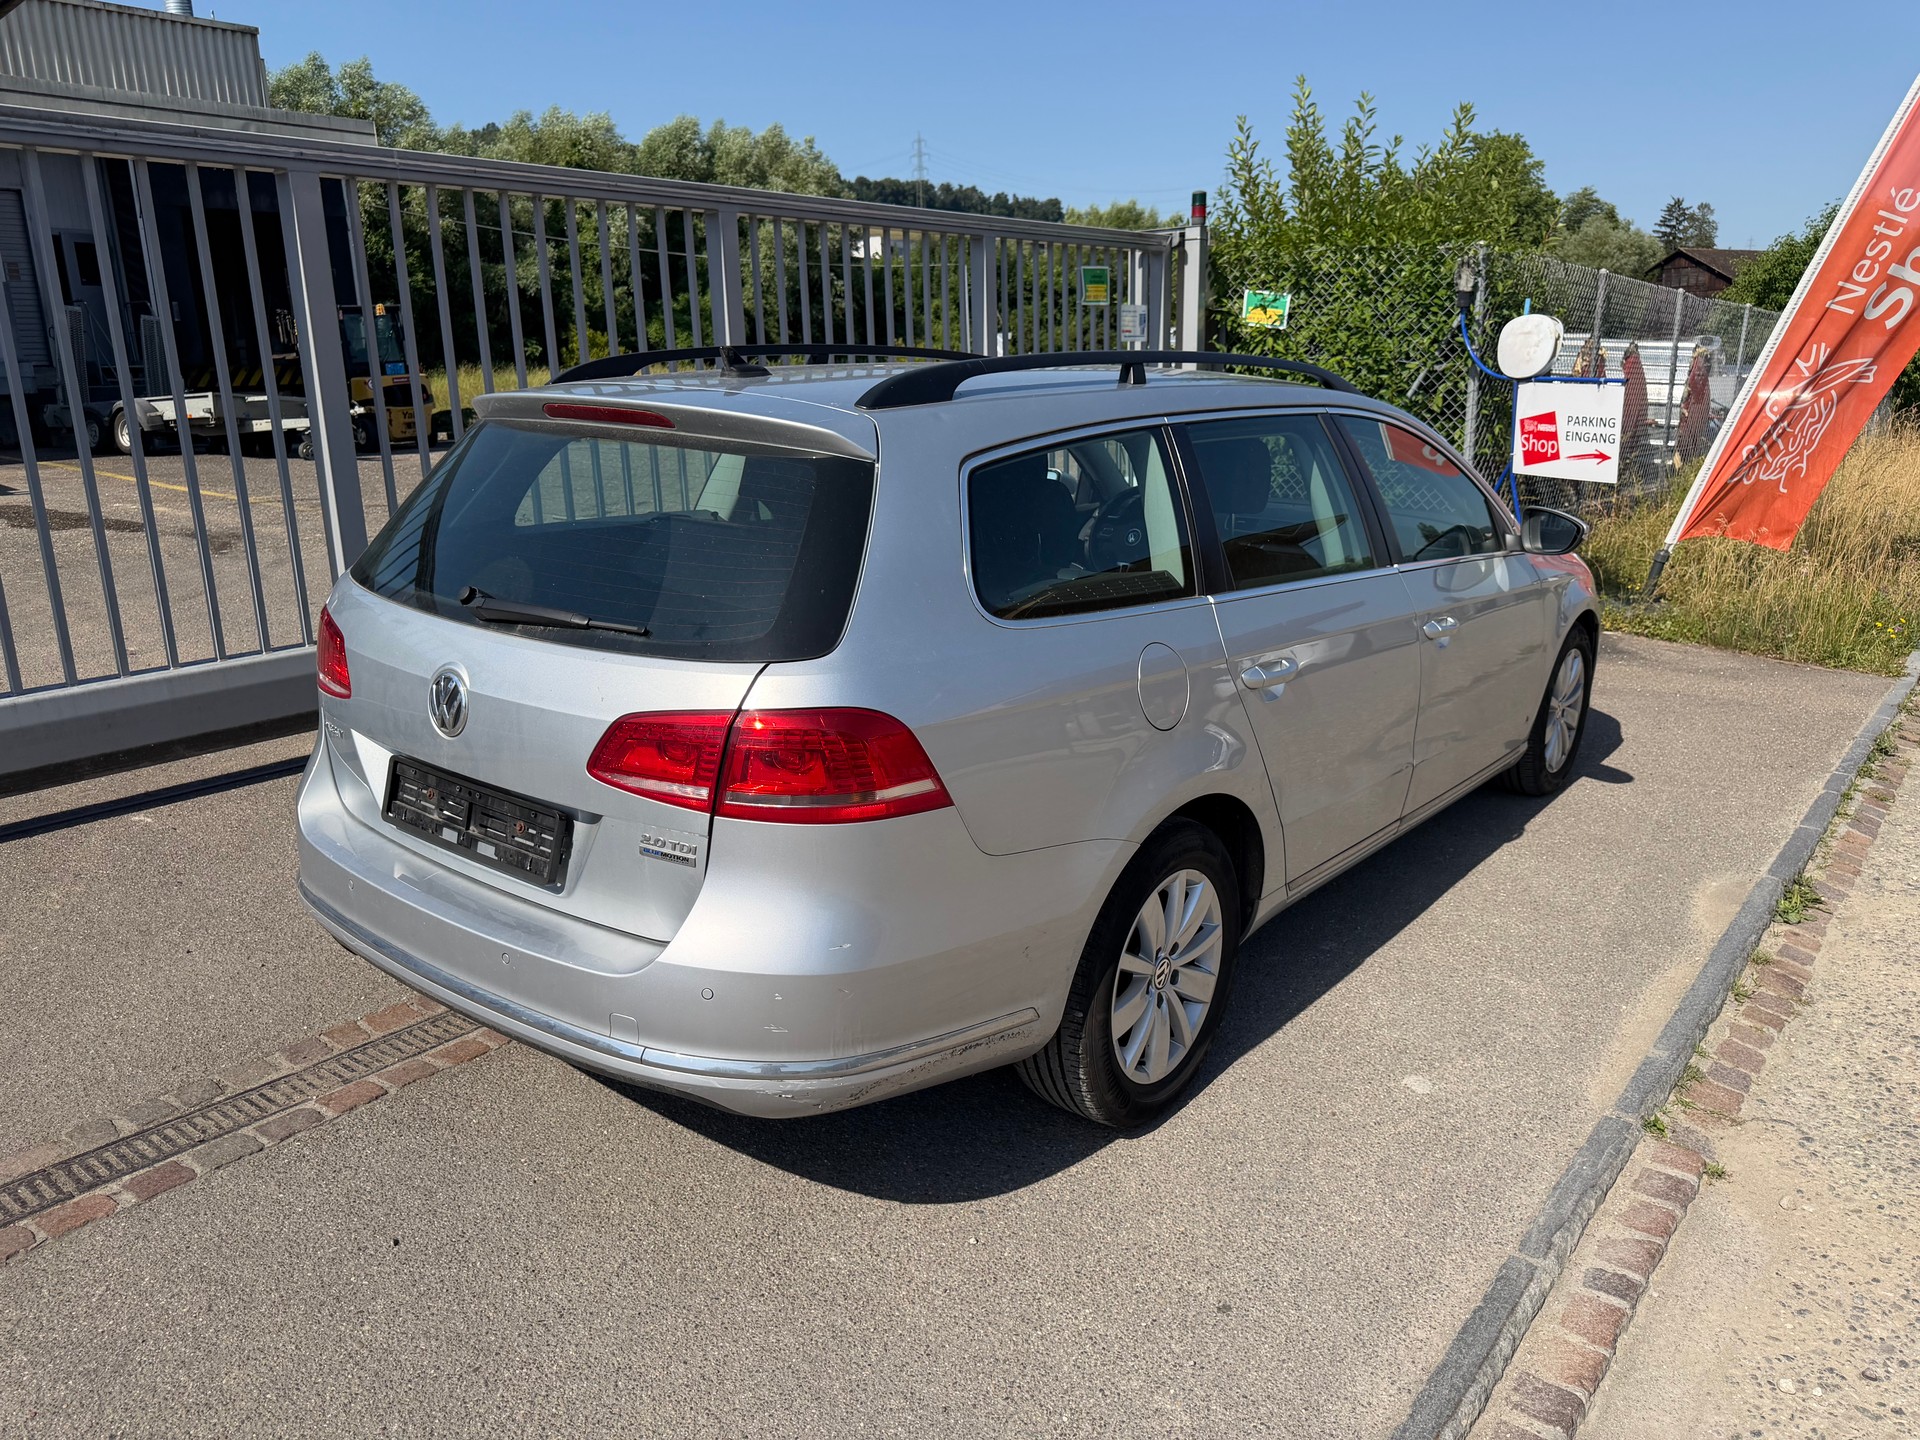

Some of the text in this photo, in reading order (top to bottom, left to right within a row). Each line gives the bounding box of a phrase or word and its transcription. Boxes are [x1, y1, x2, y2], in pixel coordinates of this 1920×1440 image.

[1825, 186, 1920, 315] Nestlé
[1566, 415, 1616, 429] PARKING
[1521, 433, 1558, 458] Shop
[1565, 430, 1616, 445] EINGANG
[640, 833, 698, 856] 2.0 TDI
